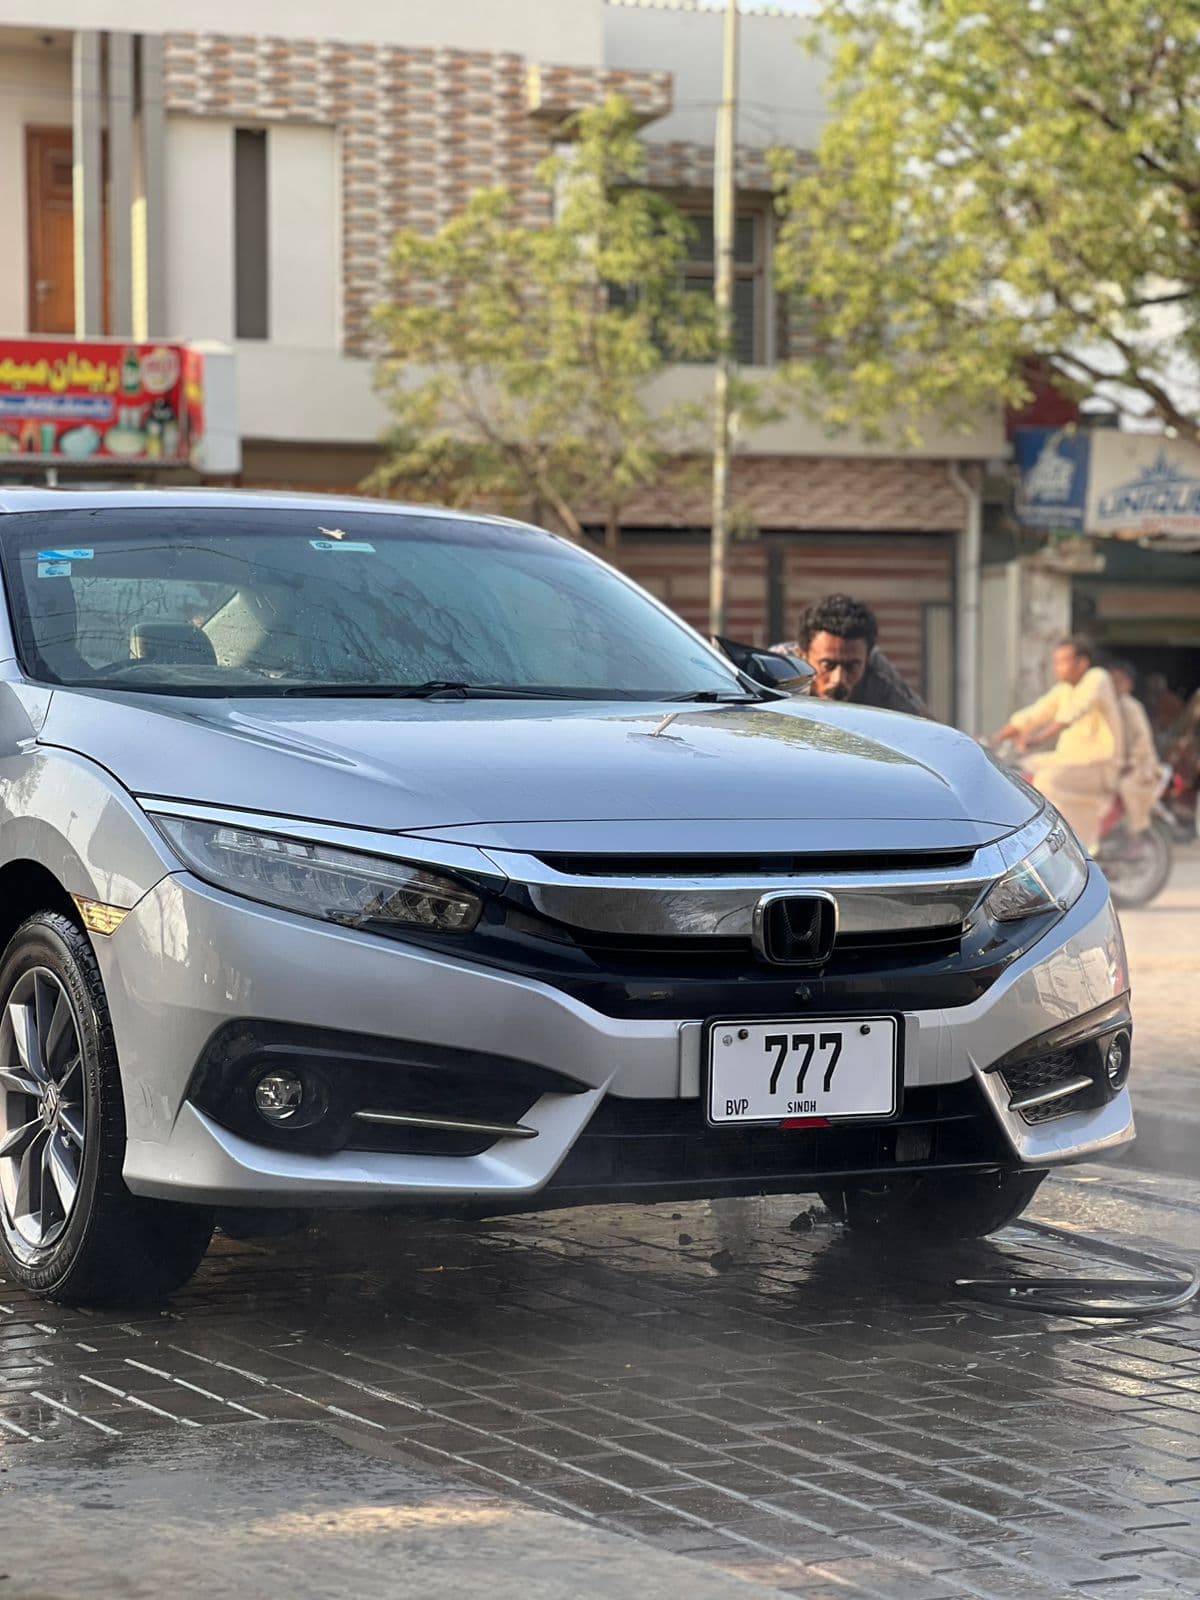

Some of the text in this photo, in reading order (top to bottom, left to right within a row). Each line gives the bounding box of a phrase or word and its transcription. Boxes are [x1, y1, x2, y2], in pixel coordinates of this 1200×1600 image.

[1097, 484, 1200, 519] UNIQU
[765, 1033, 843, 1094] 777
[726, 1099, 817, 1115] BVP SINDH
